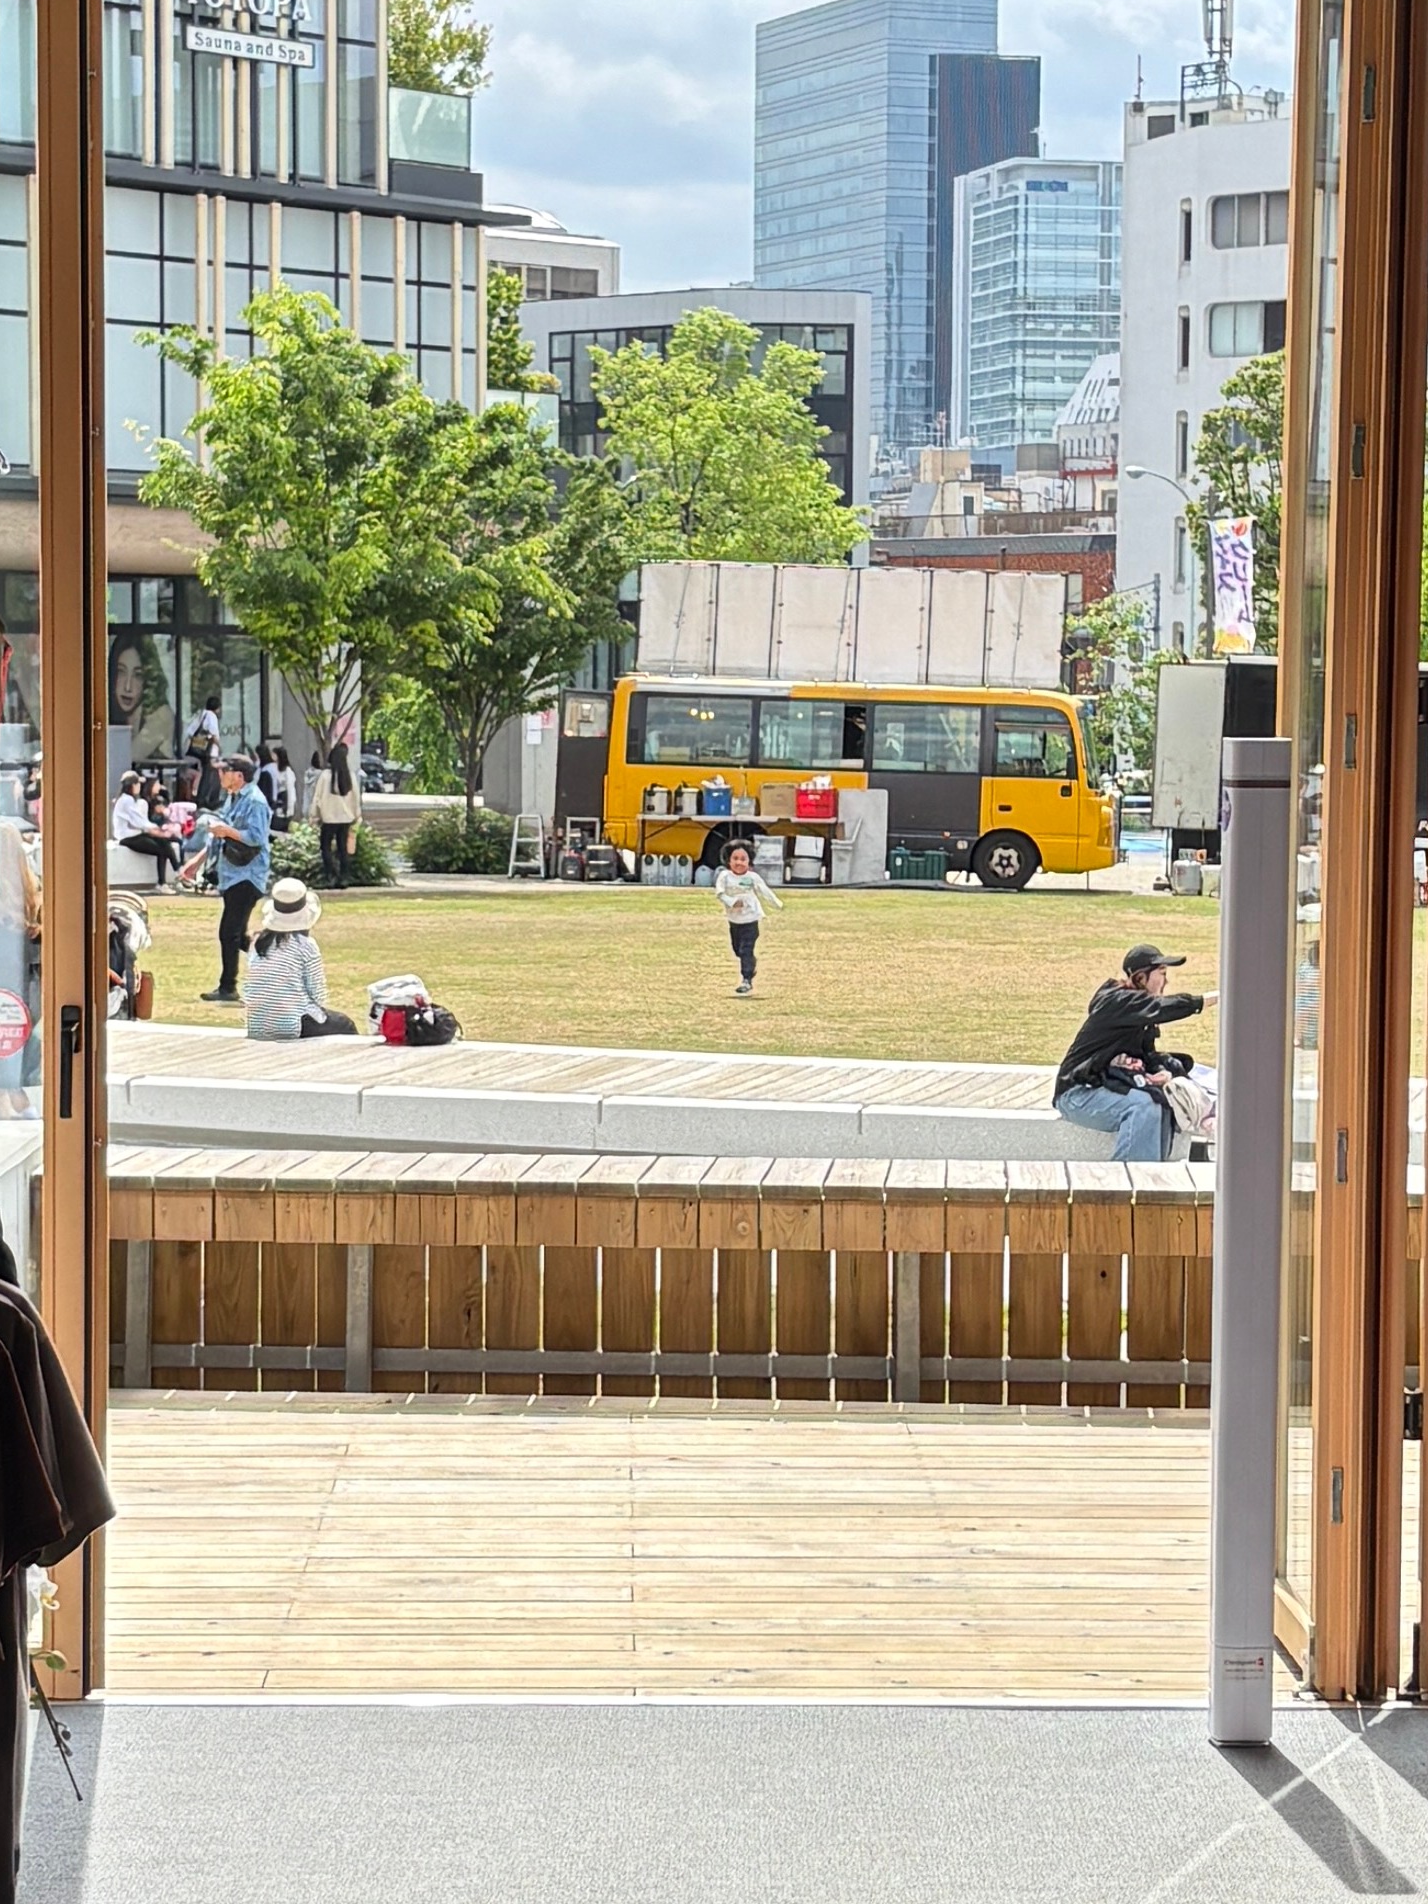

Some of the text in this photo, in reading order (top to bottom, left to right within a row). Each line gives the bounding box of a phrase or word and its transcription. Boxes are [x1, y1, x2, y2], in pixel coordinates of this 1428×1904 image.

[194, 31, 306, 63] Sauna and Spa
